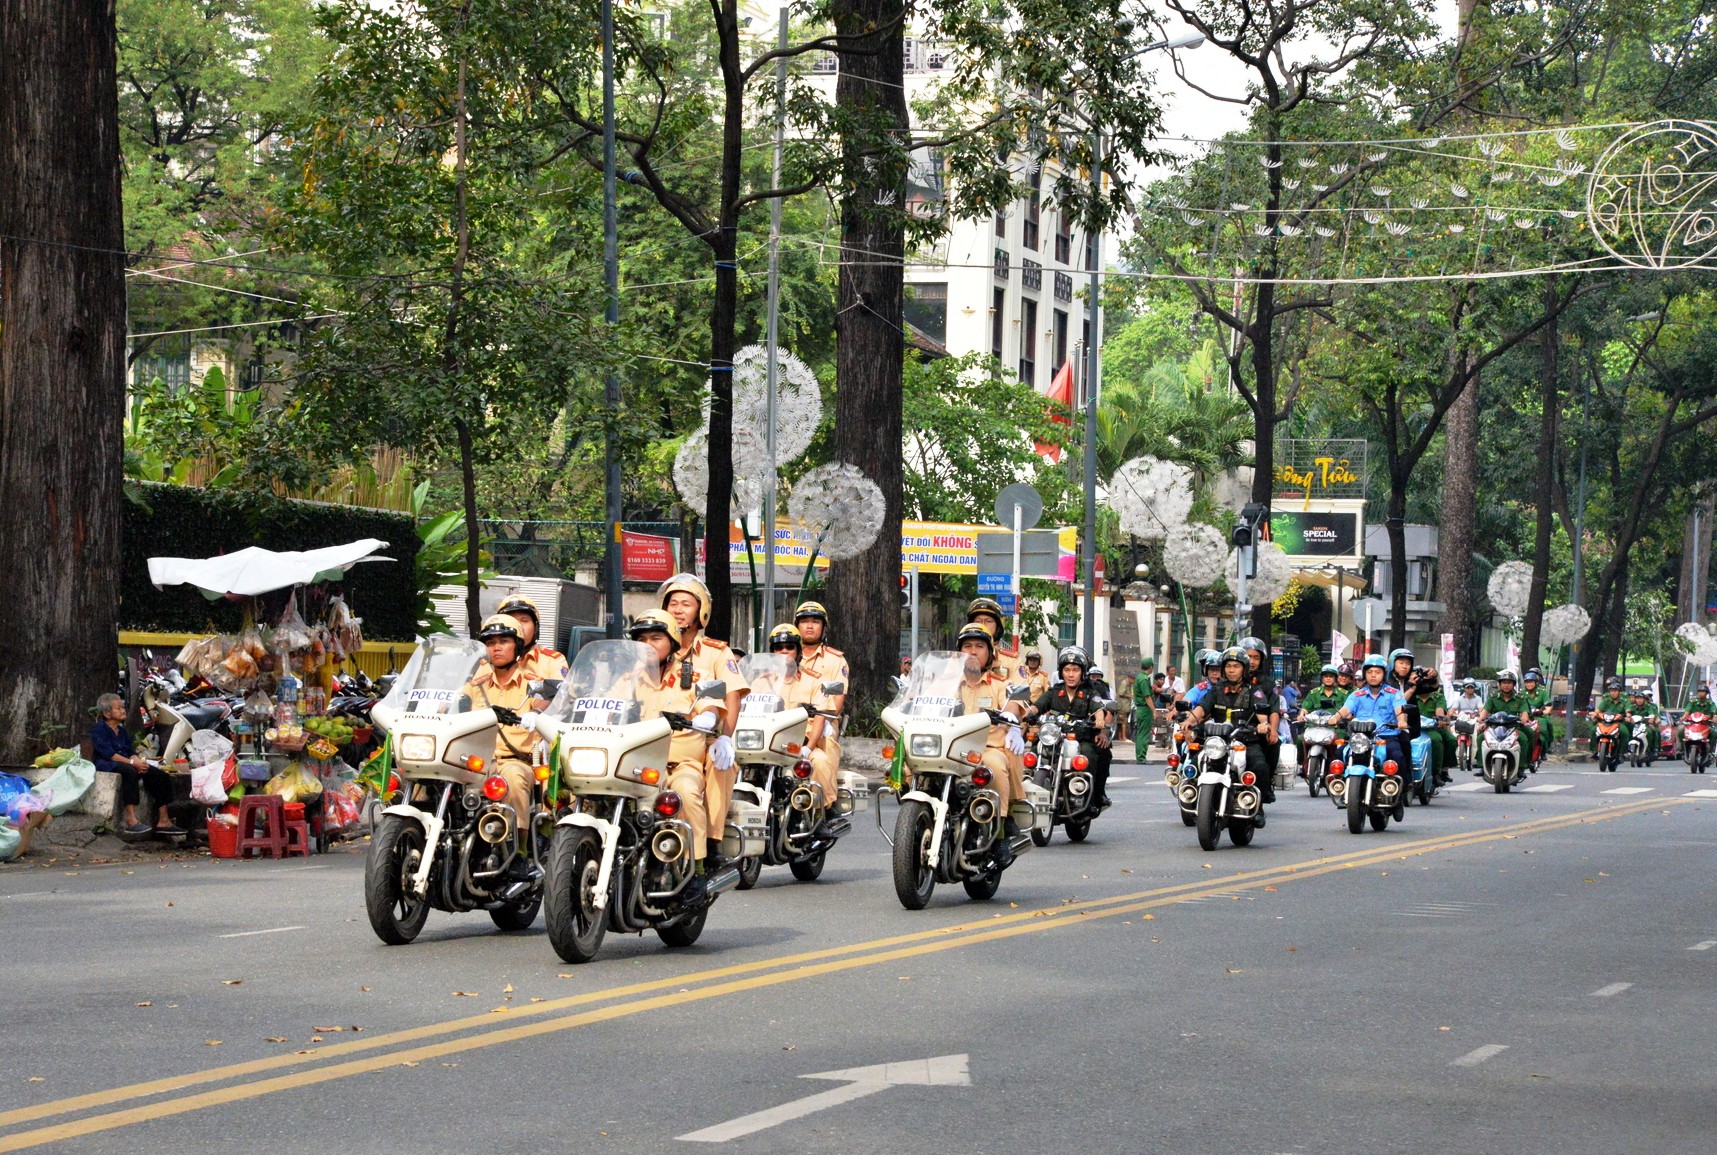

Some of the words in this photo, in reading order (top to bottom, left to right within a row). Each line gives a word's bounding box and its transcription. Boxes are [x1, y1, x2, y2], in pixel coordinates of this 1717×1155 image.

[1303, 530, 1338, 538] SPECIAL
[933, 534, 972, 549] KHÔNG
[410, 690, 455, 702] POLICE
[745, 693, 775, 704] OLICE
[576, 699, 625, 712] POLICE
[915, 696, 955, 708] POLICE
[404, 714, 442, 722] HONDA
[571, 725, 613, 734] HONDA
